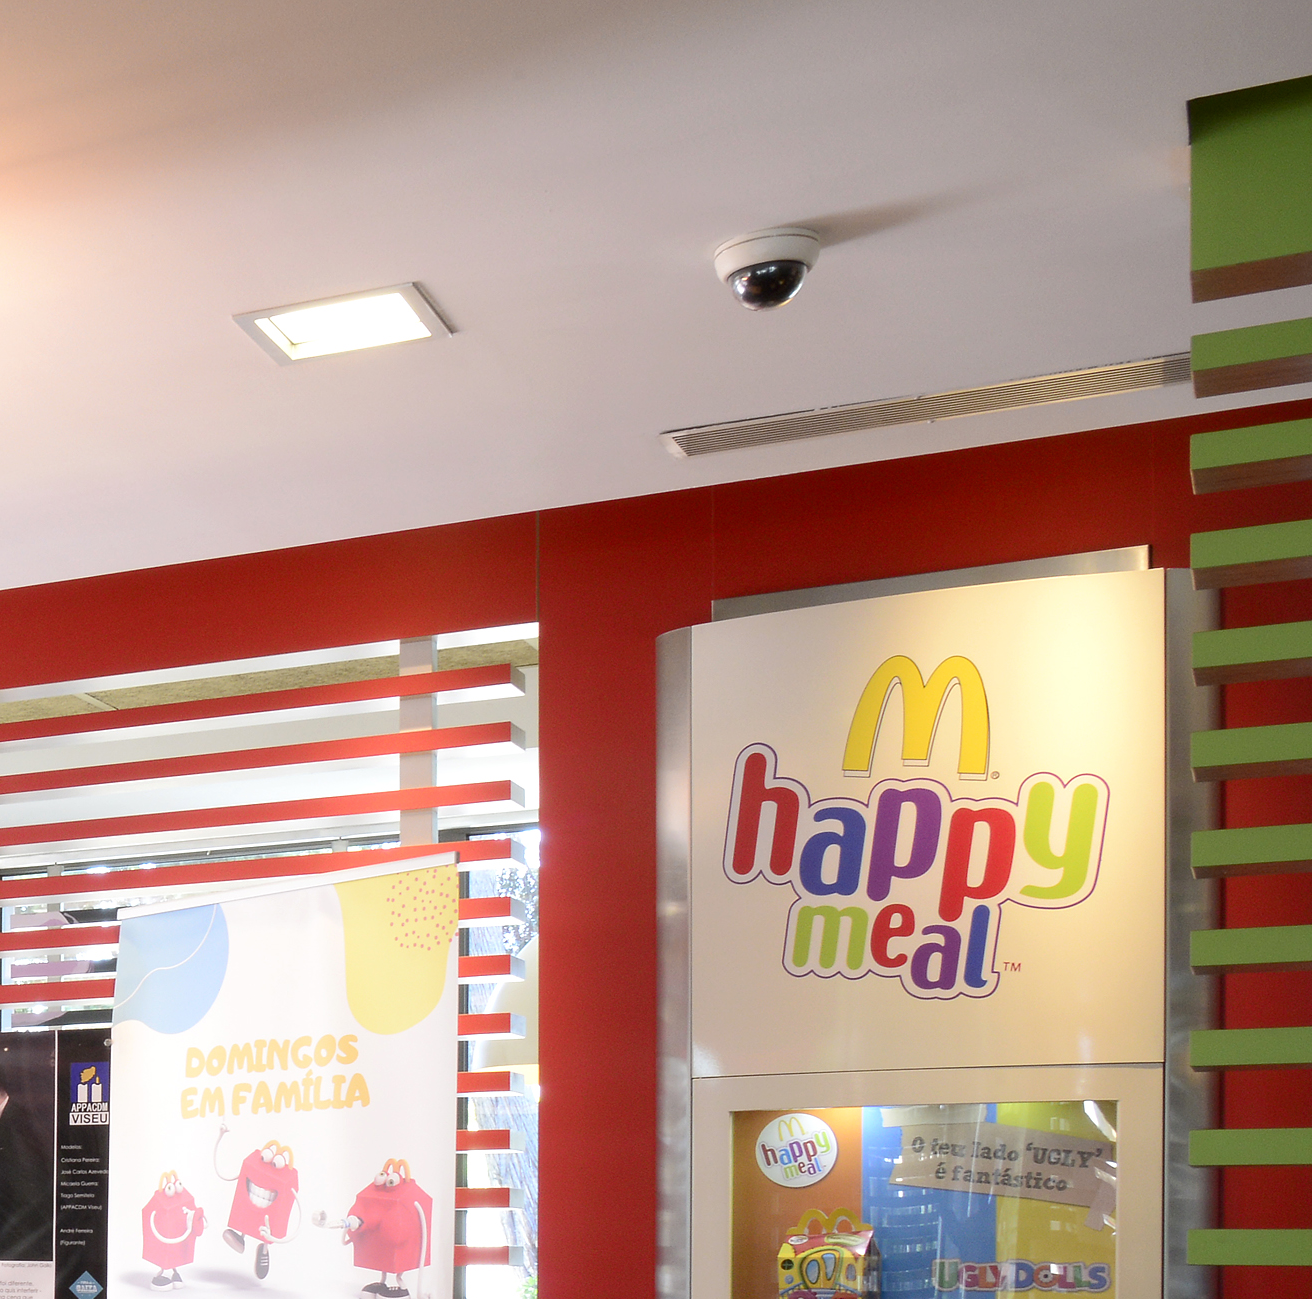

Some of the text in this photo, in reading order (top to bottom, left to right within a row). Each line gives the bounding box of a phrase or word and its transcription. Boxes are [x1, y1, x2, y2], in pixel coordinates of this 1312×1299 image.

[732, 752, 1099, 922] happy
[792, 903, 991, 990] meal
[185, 1034, 359, 1078] DOMINGOS
[71, 1102, 108, 1112] APPACDM
[180, 1069, 371, 1119] EM FAMÍLIA
[71, 1113, 108, 1124] VISEU
[761, 1131, 831, 1167] happy
[911, 1136, 925, 1153] O
[930, 1138, 965, 1157] teu
[970, 1141, 1019, 1162] lado
[784, 1160, 822, 1179] meal
[935, 1162, 1069, 1192] é fantástico
[936, 1261, 1108, 1290] UGLYDOLLS
